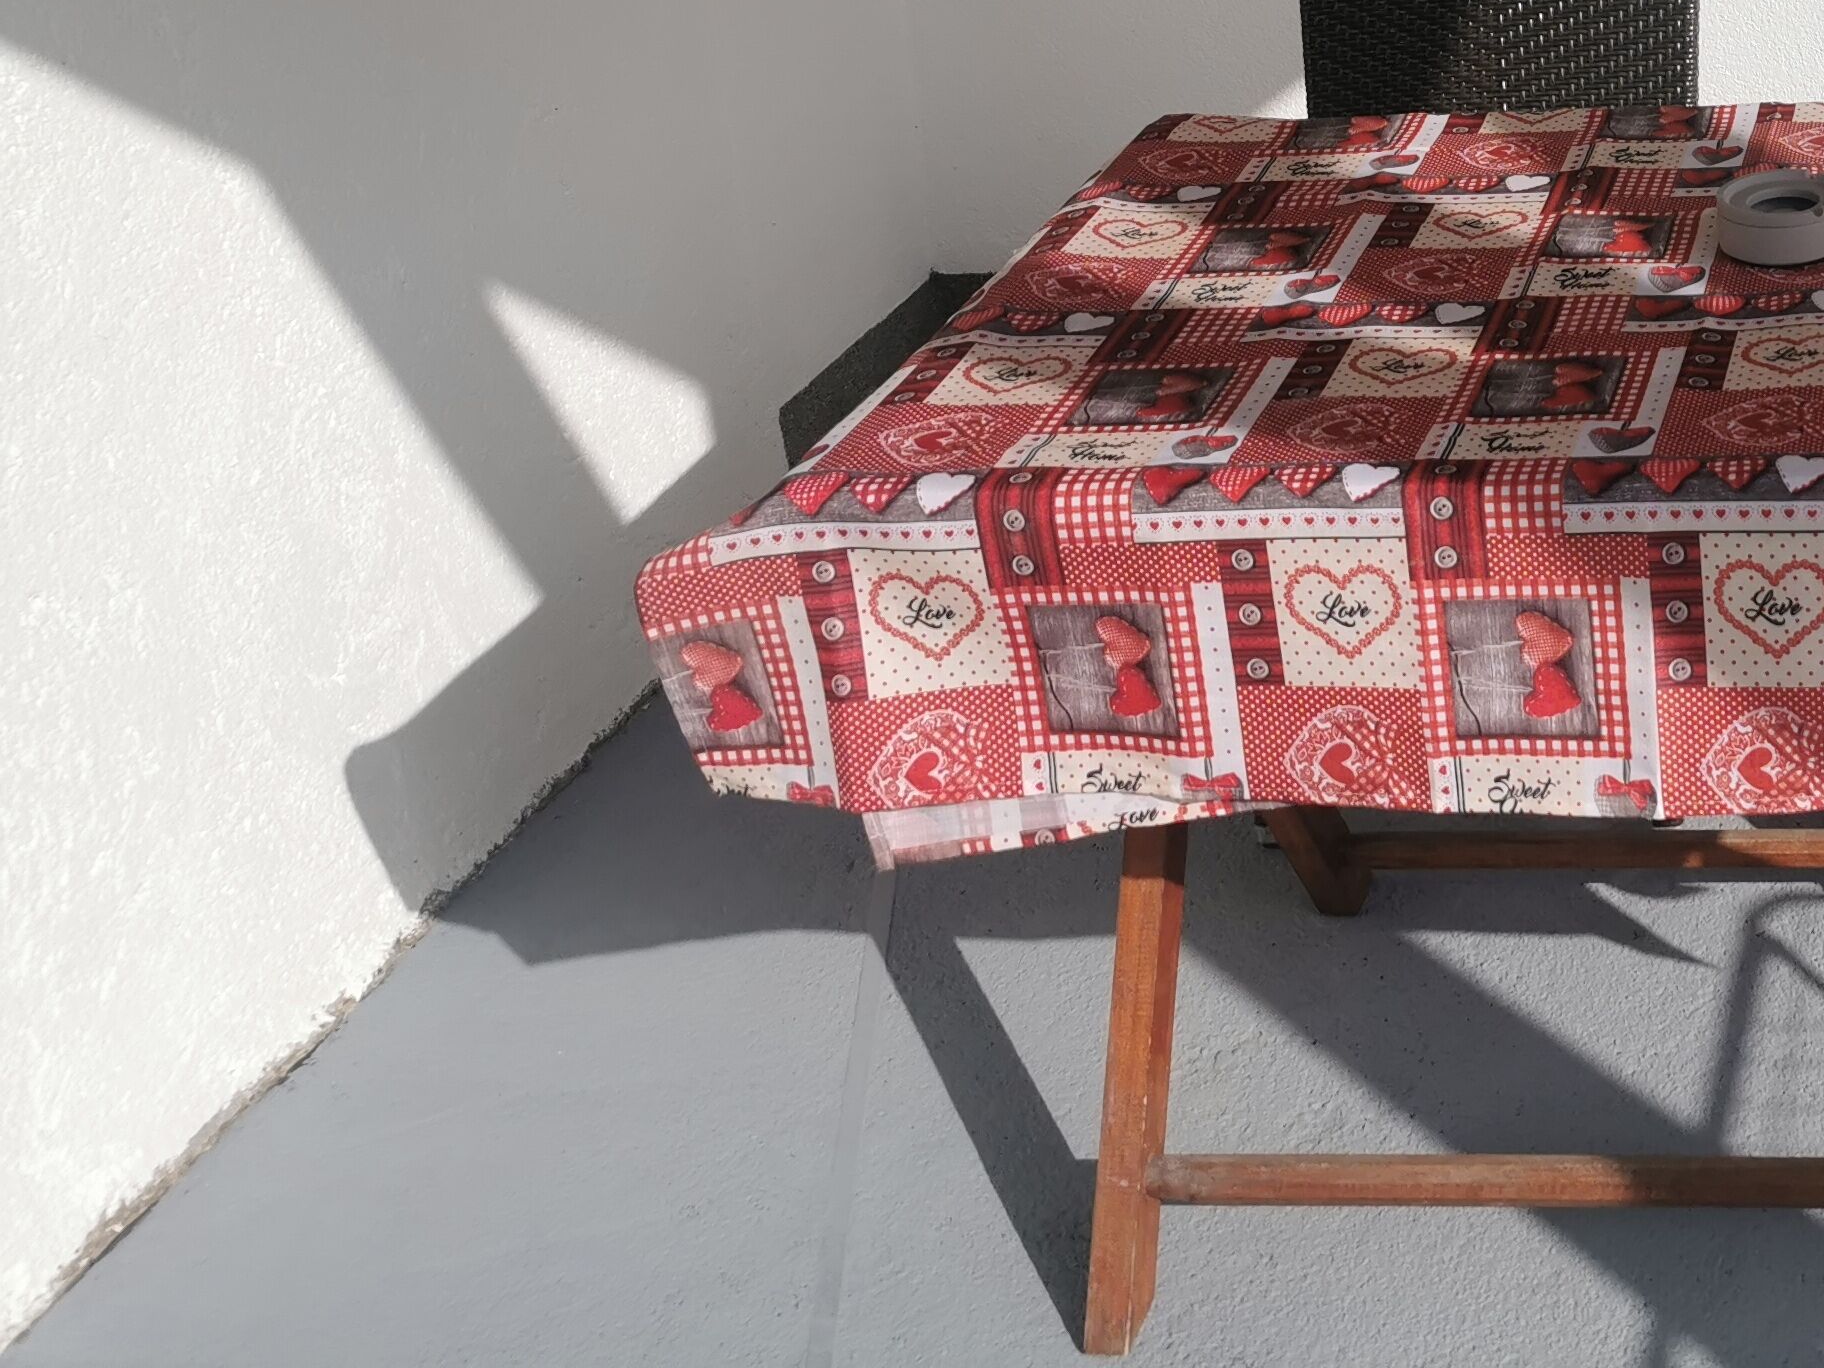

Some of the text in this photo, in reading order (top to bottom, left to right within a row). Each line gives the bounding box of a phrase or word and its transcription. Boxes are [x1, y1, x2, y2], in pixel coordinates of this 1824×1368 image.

[902, 597, 957, 629] Love
[1316, 592, 1372, 628] Love
[1744, 589, 1802, 626] Love
[1081, 763, 1147, 793] Sweet
[1488, 768, 1556, 803] Sweet
